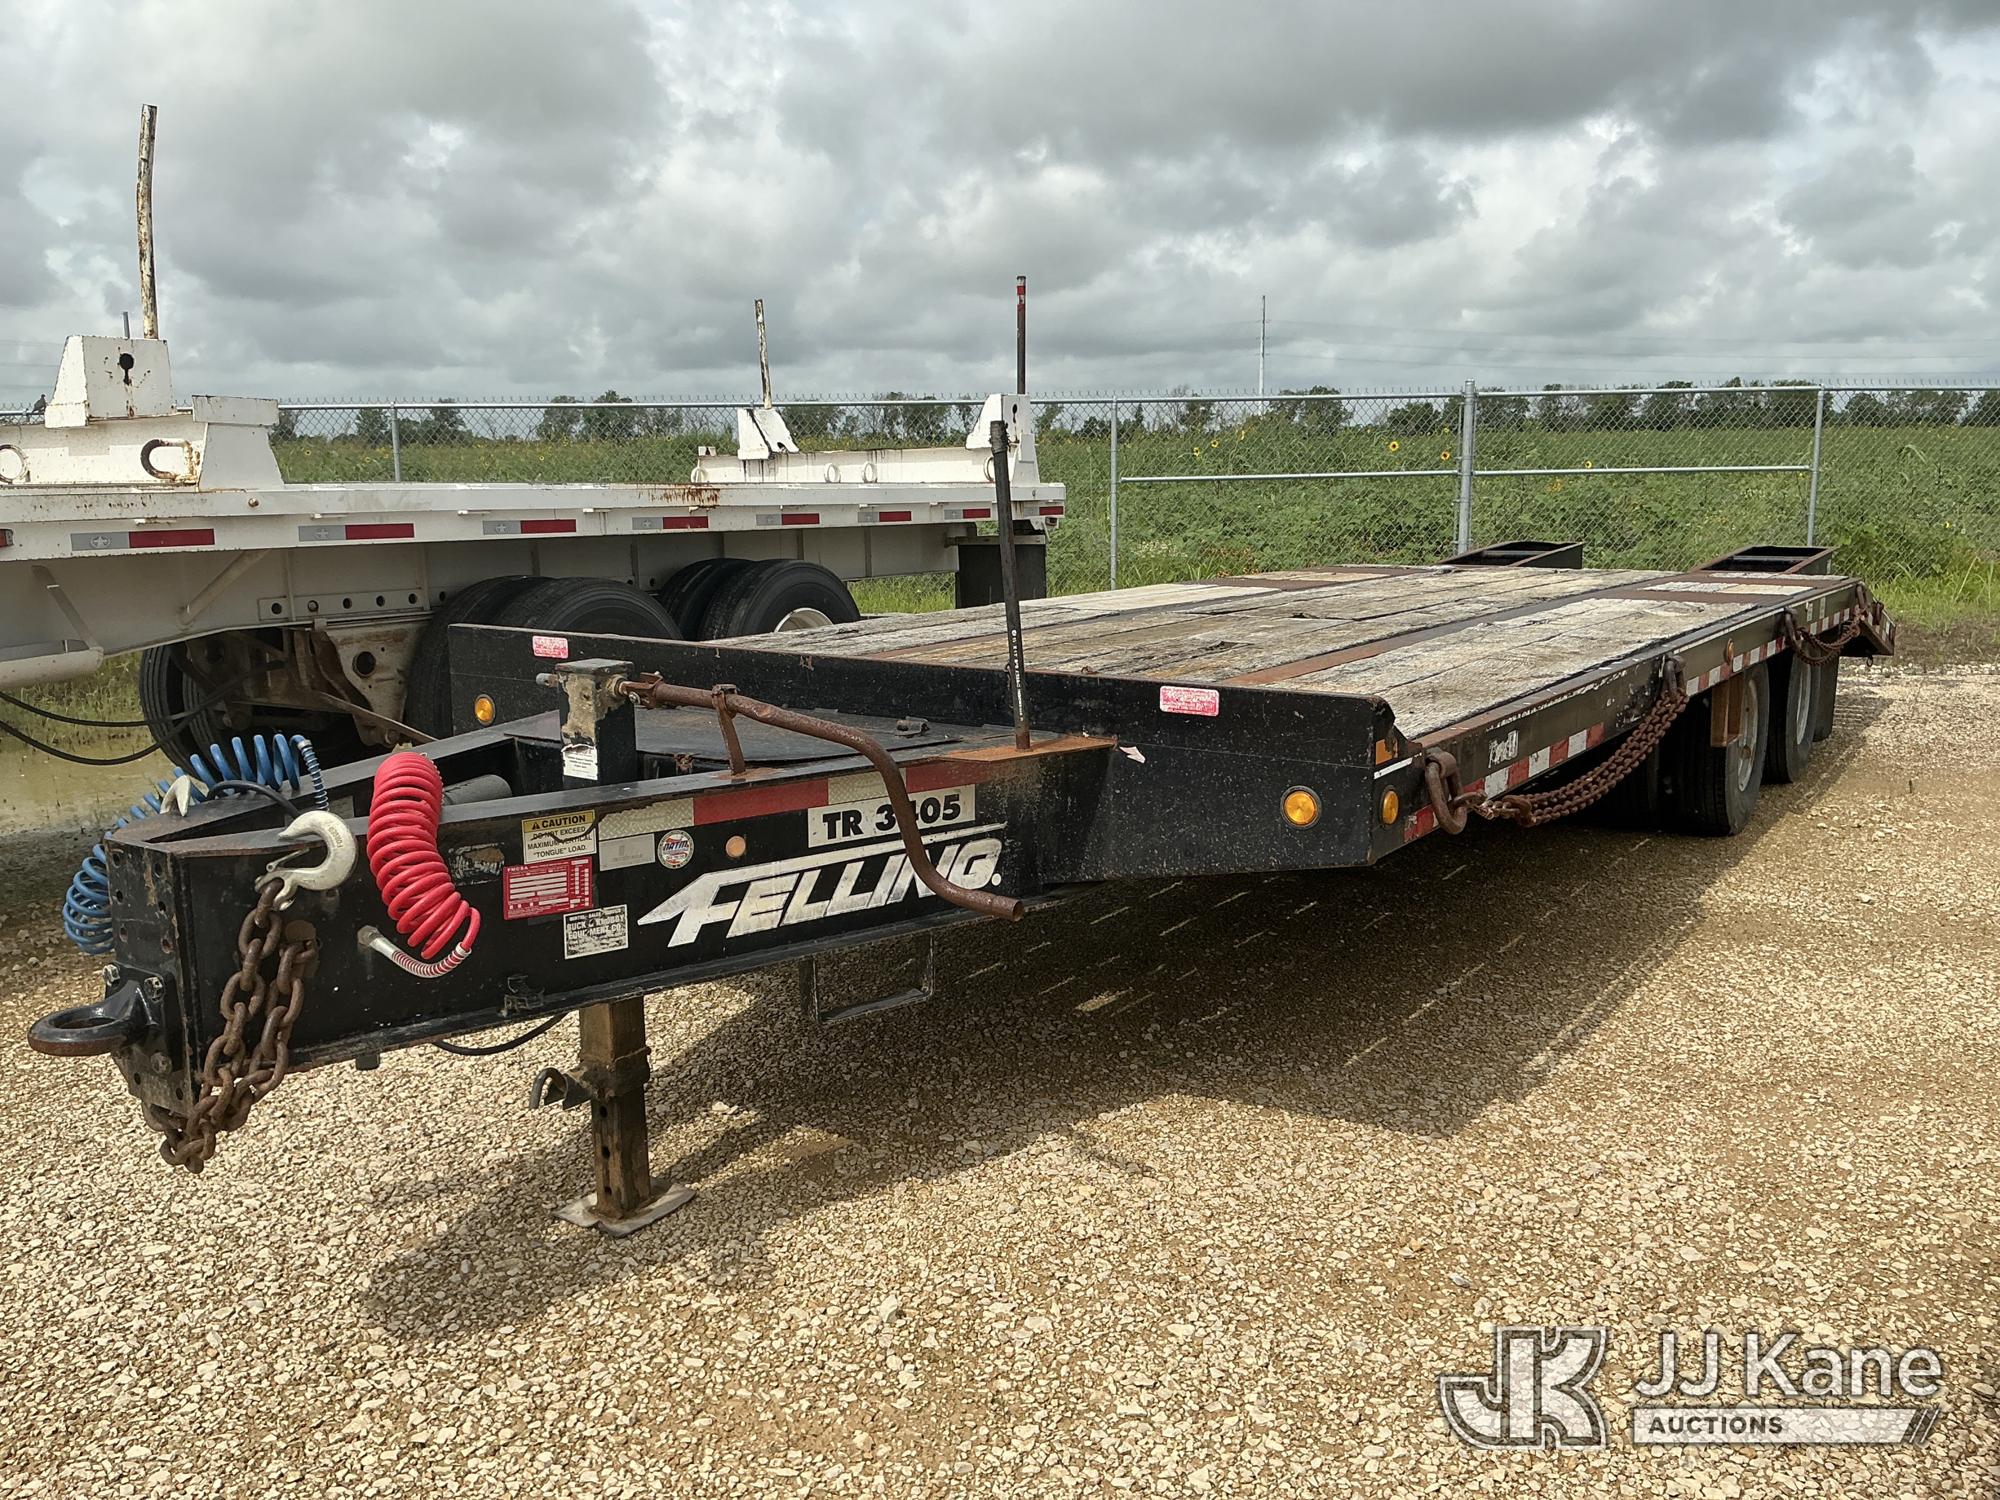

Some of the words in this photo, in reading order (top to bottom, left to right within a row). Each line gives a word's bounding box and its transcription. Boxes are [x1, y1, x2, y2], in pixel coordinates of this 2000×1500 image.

[541, 814, 586, 829] CAUTION
[823, 809, 863, 840] TR
[560, 826, 586, 836] EXCEED
[527, 839, 559, 850] MAXIMUM
[561, 834, 593, 845] VERTICAL
[533, 847, 567, 858] "TONGUE"
[568, 844, 586, 853] LOAD
